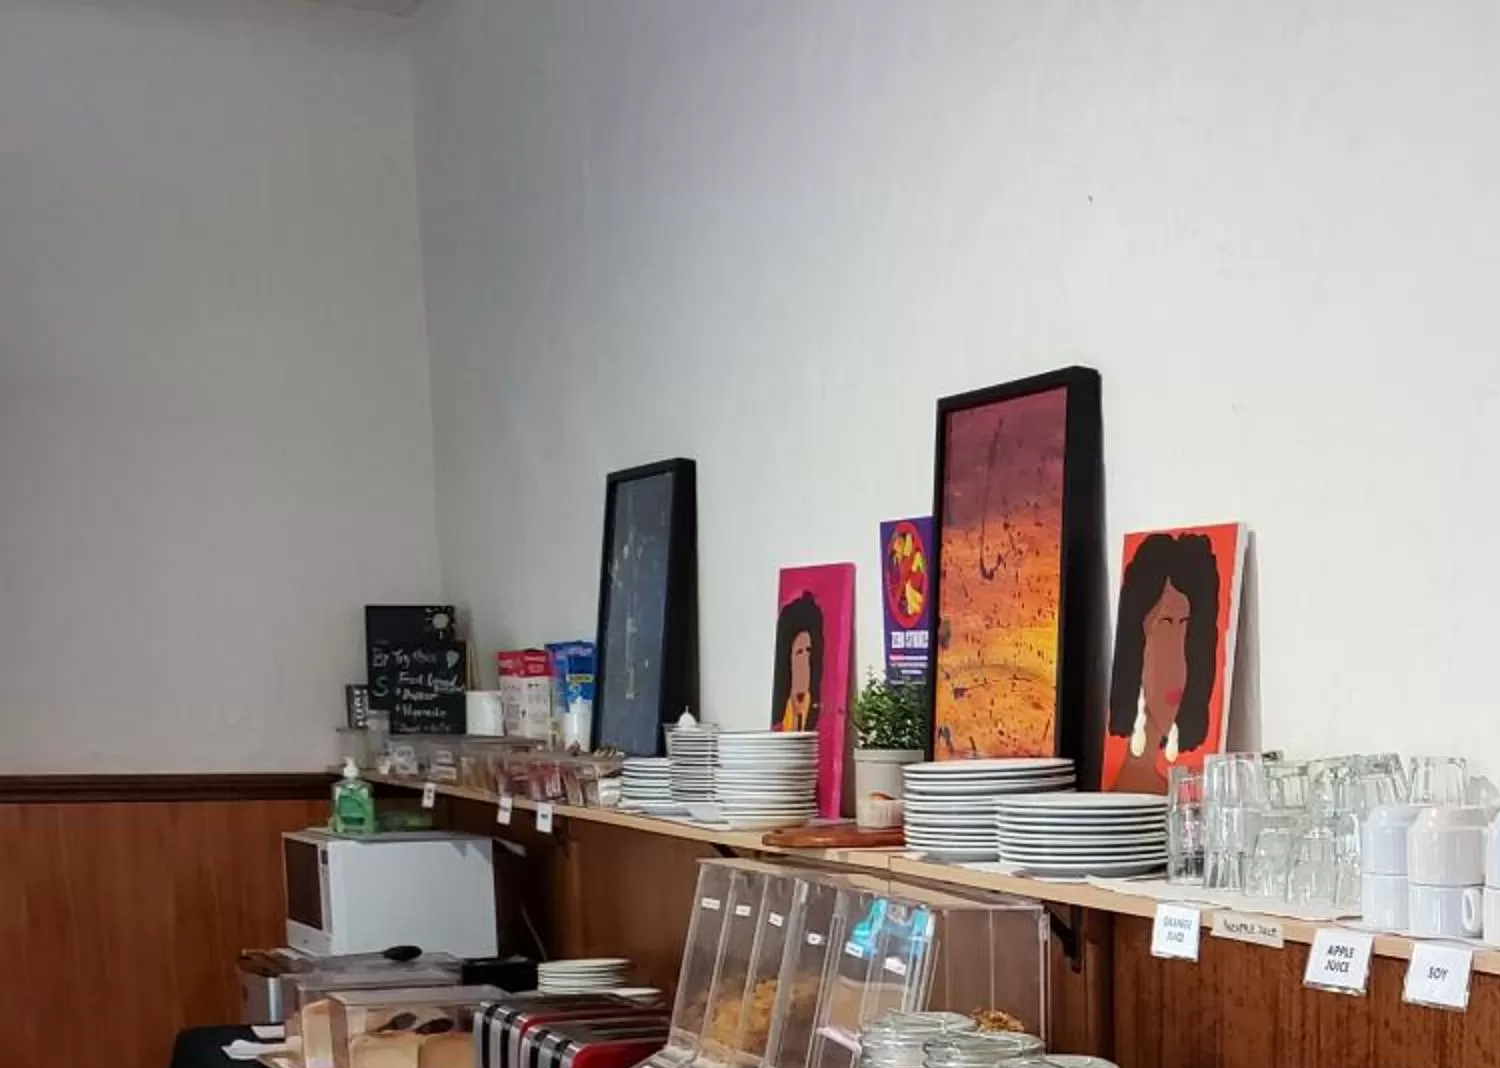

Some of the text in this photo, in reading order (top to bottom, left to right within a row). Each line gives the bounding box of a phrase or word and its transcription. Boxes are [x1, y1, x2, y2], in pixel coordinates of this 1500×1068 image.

[1327, 945, 1354, 959] APPLE
[1324, 960, 1350, 973] JUICE
[1428, 965, 1449, 983] SOY
